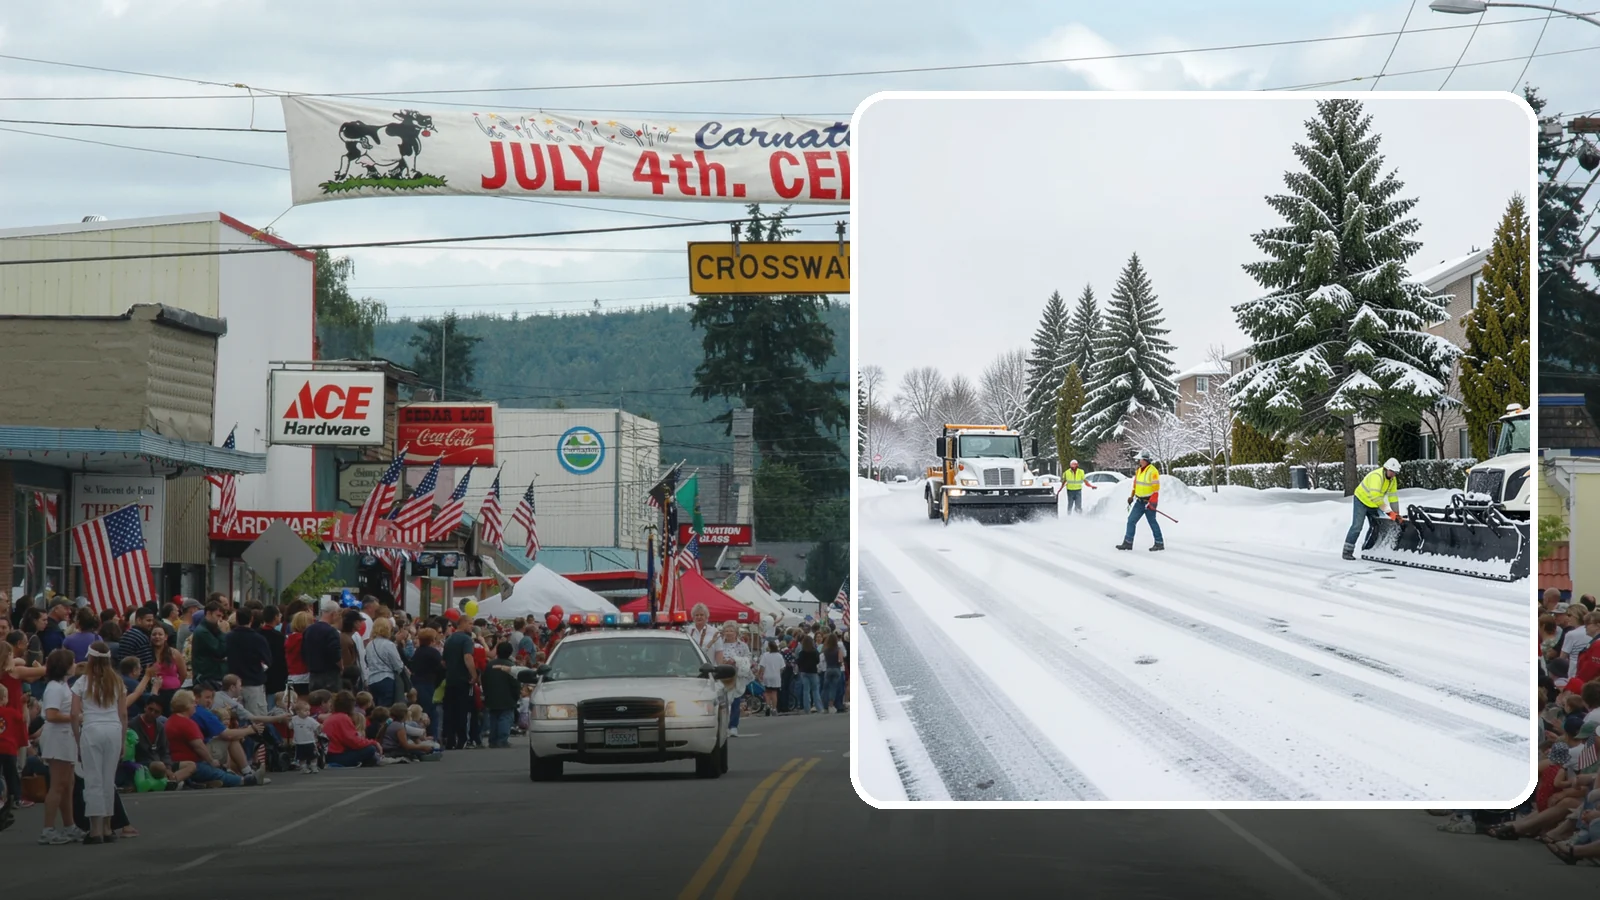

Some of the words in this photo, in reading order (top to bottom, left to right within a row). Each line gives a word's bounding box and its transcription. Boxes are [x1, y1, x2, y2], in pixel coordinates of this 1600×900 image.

[481, 140, 605, 192] JULY
[632, 149, 747, 198] 4th.
[696, 254, 850, 280] CROSSWA
[283, 380, 374, 420] ACE
[405, 409, 453, 422] CEDAR
[283, 421, 371, 437] Hardware
[353, 467, 385, 483] Simpl
[83, 485, 94, 494] St.
[96, 485, 125, 494] Vincent
[126, 486, 135, 494] de
[137, 486, 155, 495] Paul
[688, 527, 742, 535] CRNATION
[700, 535, 730, 543] GLASS
